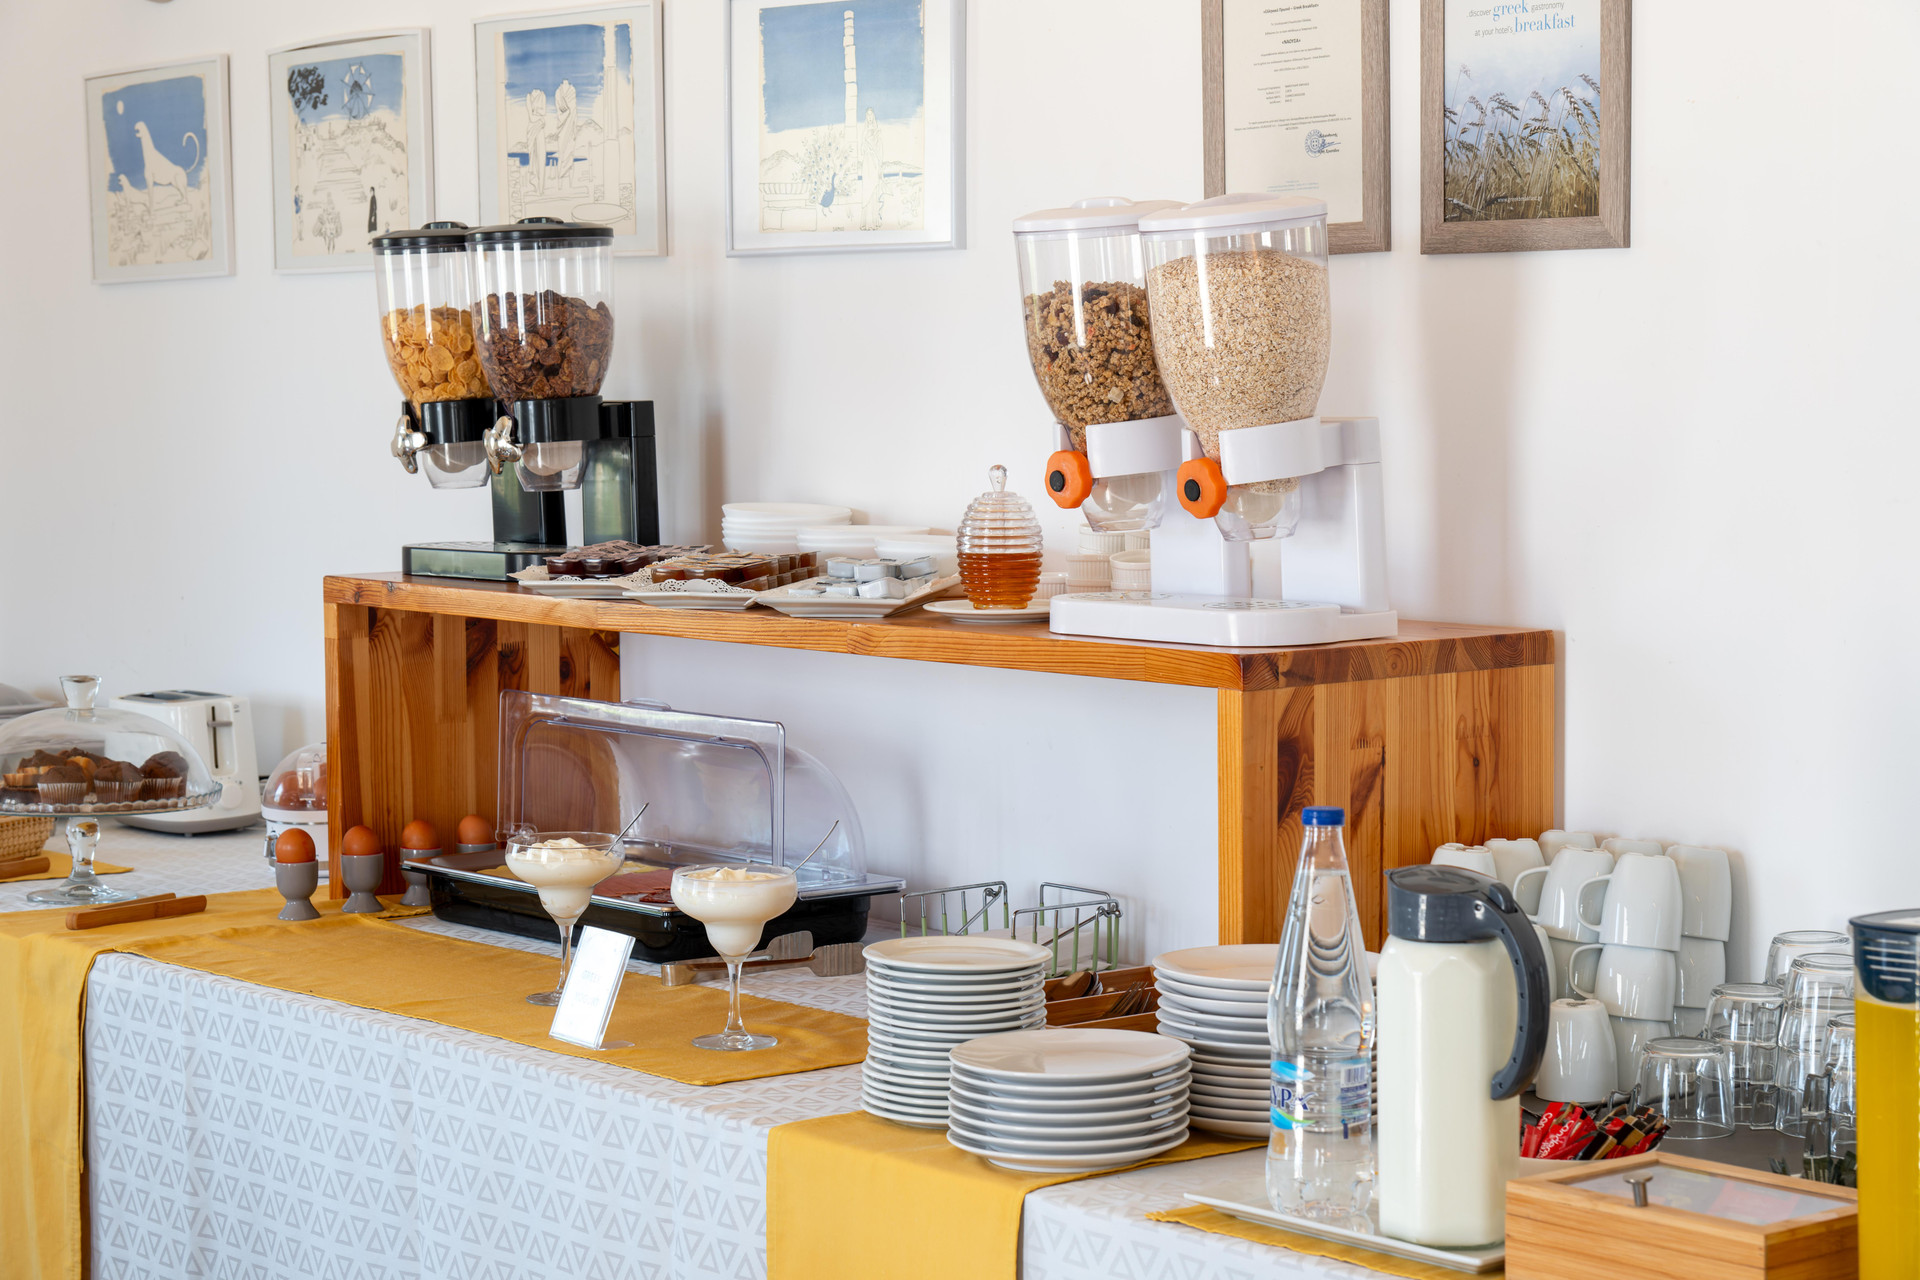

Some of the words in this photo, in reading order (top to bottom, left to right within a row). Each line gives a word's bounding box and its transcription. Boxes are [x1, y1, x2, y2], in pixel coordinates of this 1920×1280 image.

[1493, 0, 1529, 21] greek
[1531, 2, 1565, 13] gastronomy
[1481, 27, 1494, 37] your
[1515, 12, 1576, 33] breakfast
